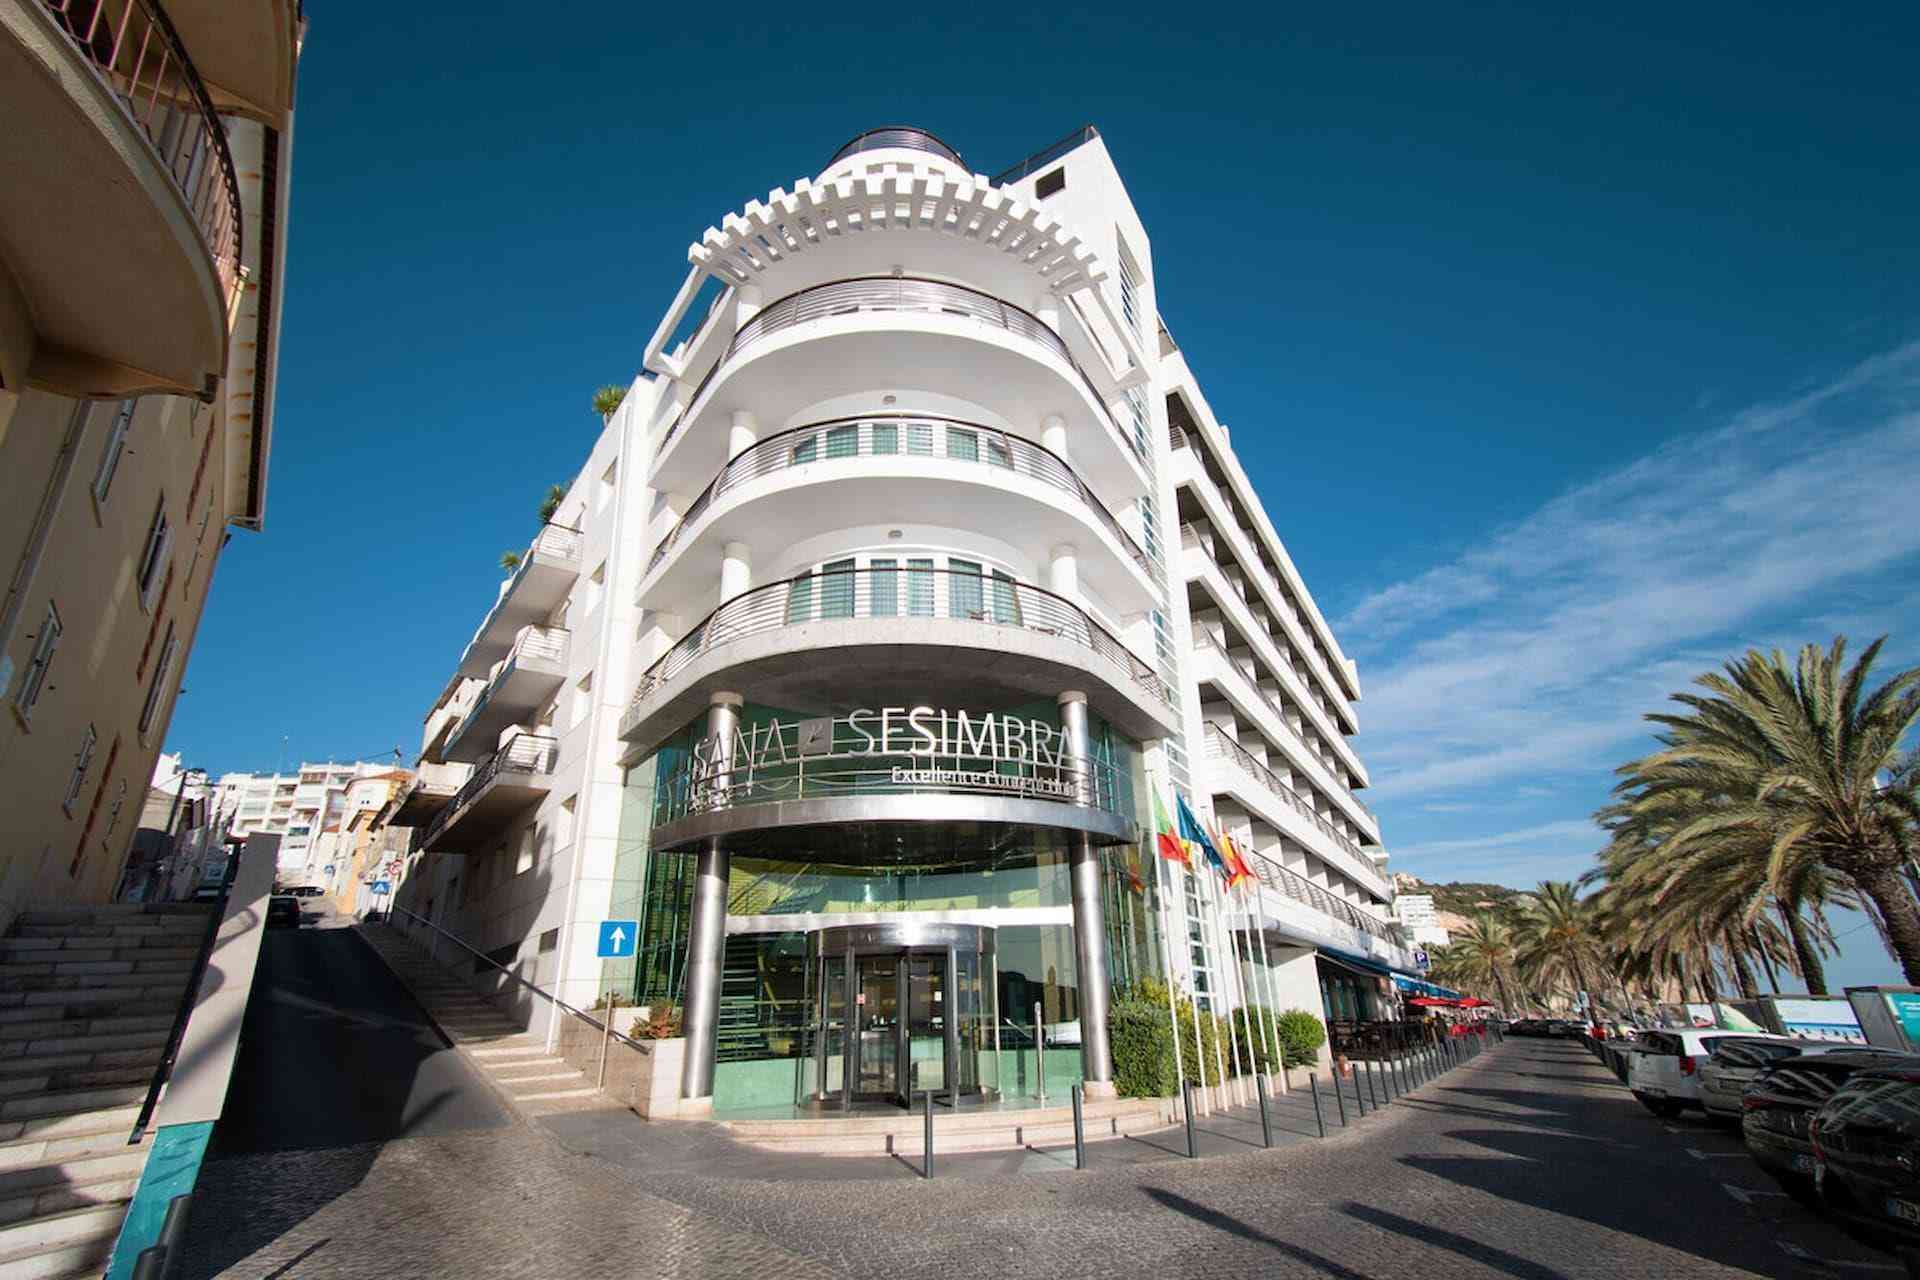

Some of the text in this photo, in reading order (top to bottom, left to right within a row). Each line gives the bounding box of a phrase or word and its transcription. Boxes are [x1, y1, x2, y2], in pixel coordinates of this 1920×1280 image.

[694, 706, 1074, 783] SANA SESIMBRA
[892, 766, 984, 787] Excellence
